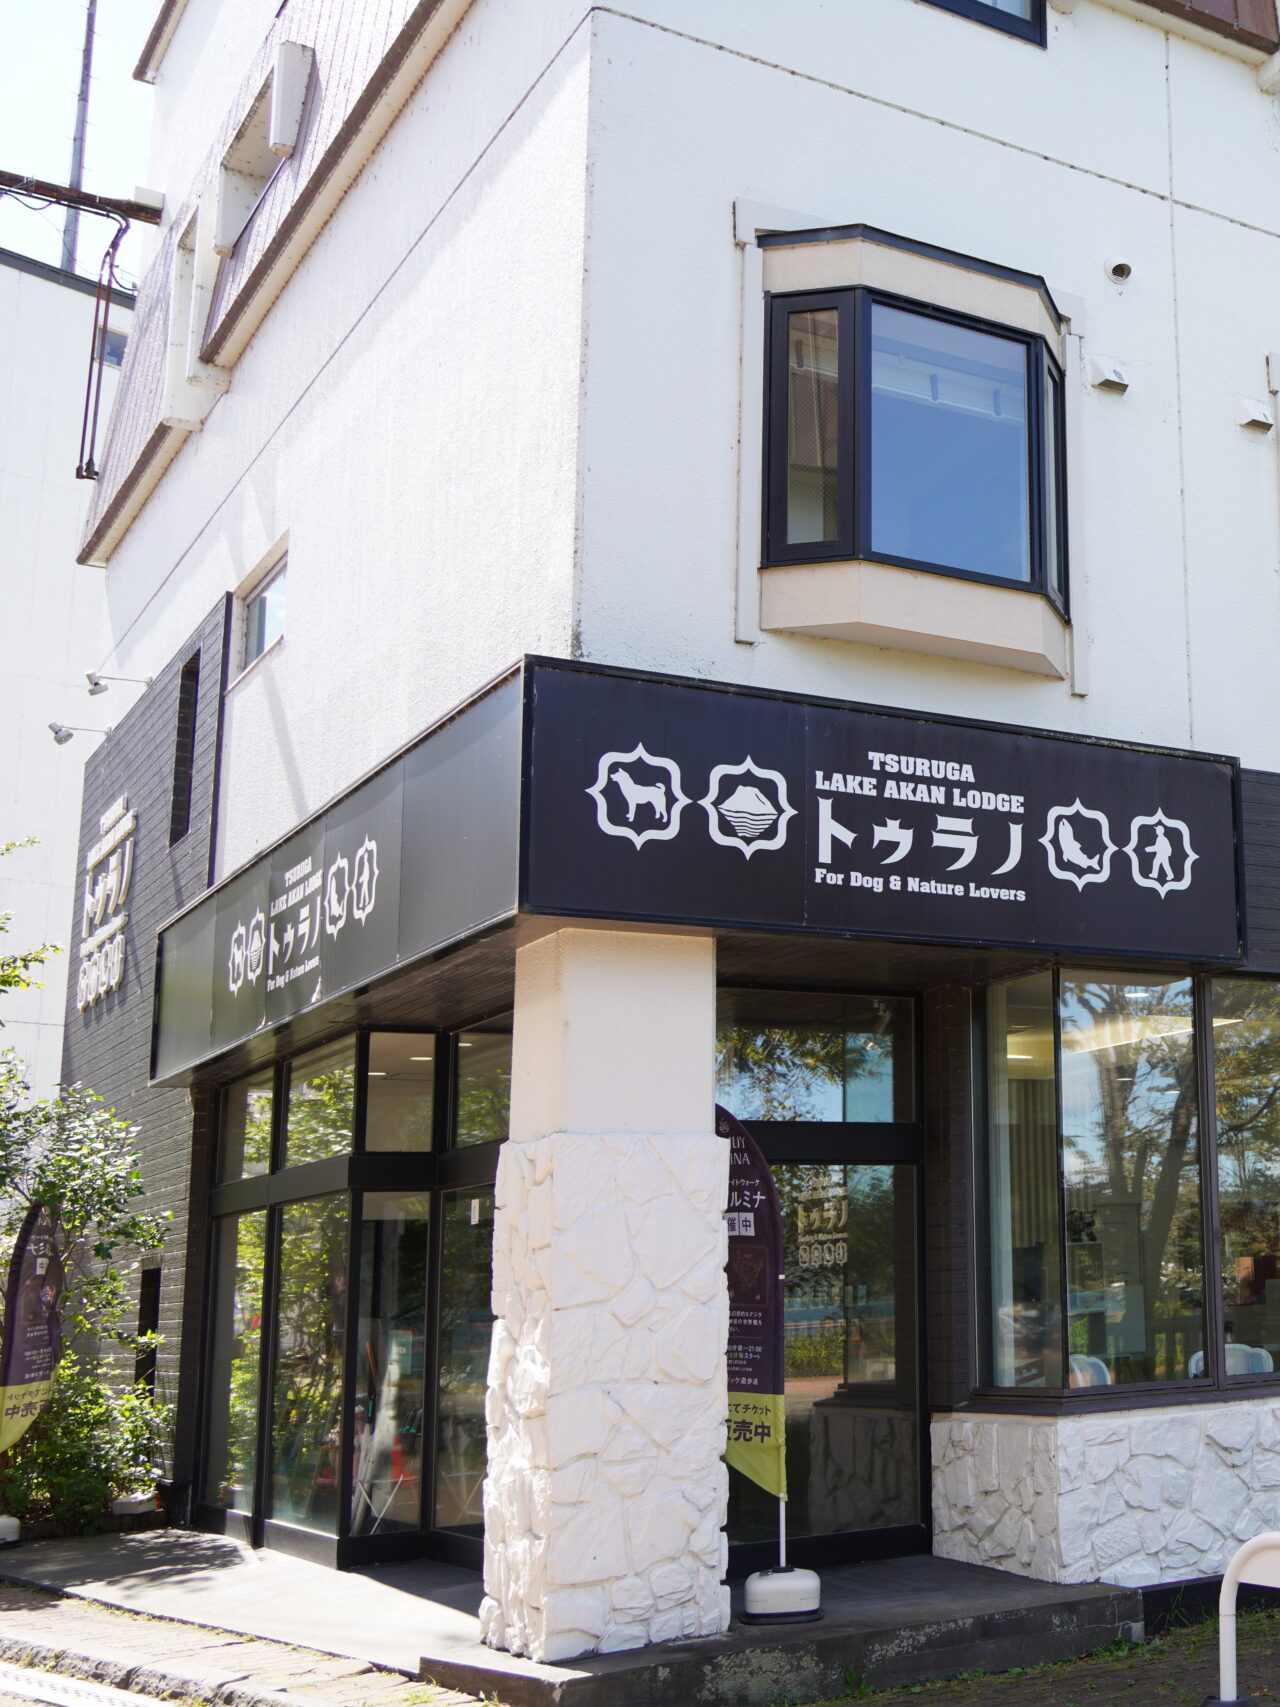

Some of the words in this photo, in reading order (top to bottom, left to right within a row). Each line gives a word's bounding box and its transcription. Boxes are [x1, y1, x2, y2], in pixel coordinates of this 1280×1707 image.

[868, 751, 975, 783] TSURUGA
[815, 770, 877, 797] LAKE
[883, 779, 946, 805] AKAN
[952, 787, 1025, 814] LODGE
[817, 795, 1024, 875] トゥラノ
[814, 867, 844, 885] For
[850, 871, 884, 892] Dog
[889, 875, 901, 892] &
[907, 876, 965, 897] Nature
[969, 882, 1026, 902] Lovers
[729, 1136, 746, 1149] UY
[729, 1179, 760, 1187] イトウォーク
[730, 1190, 767, 1208] ルミナ
